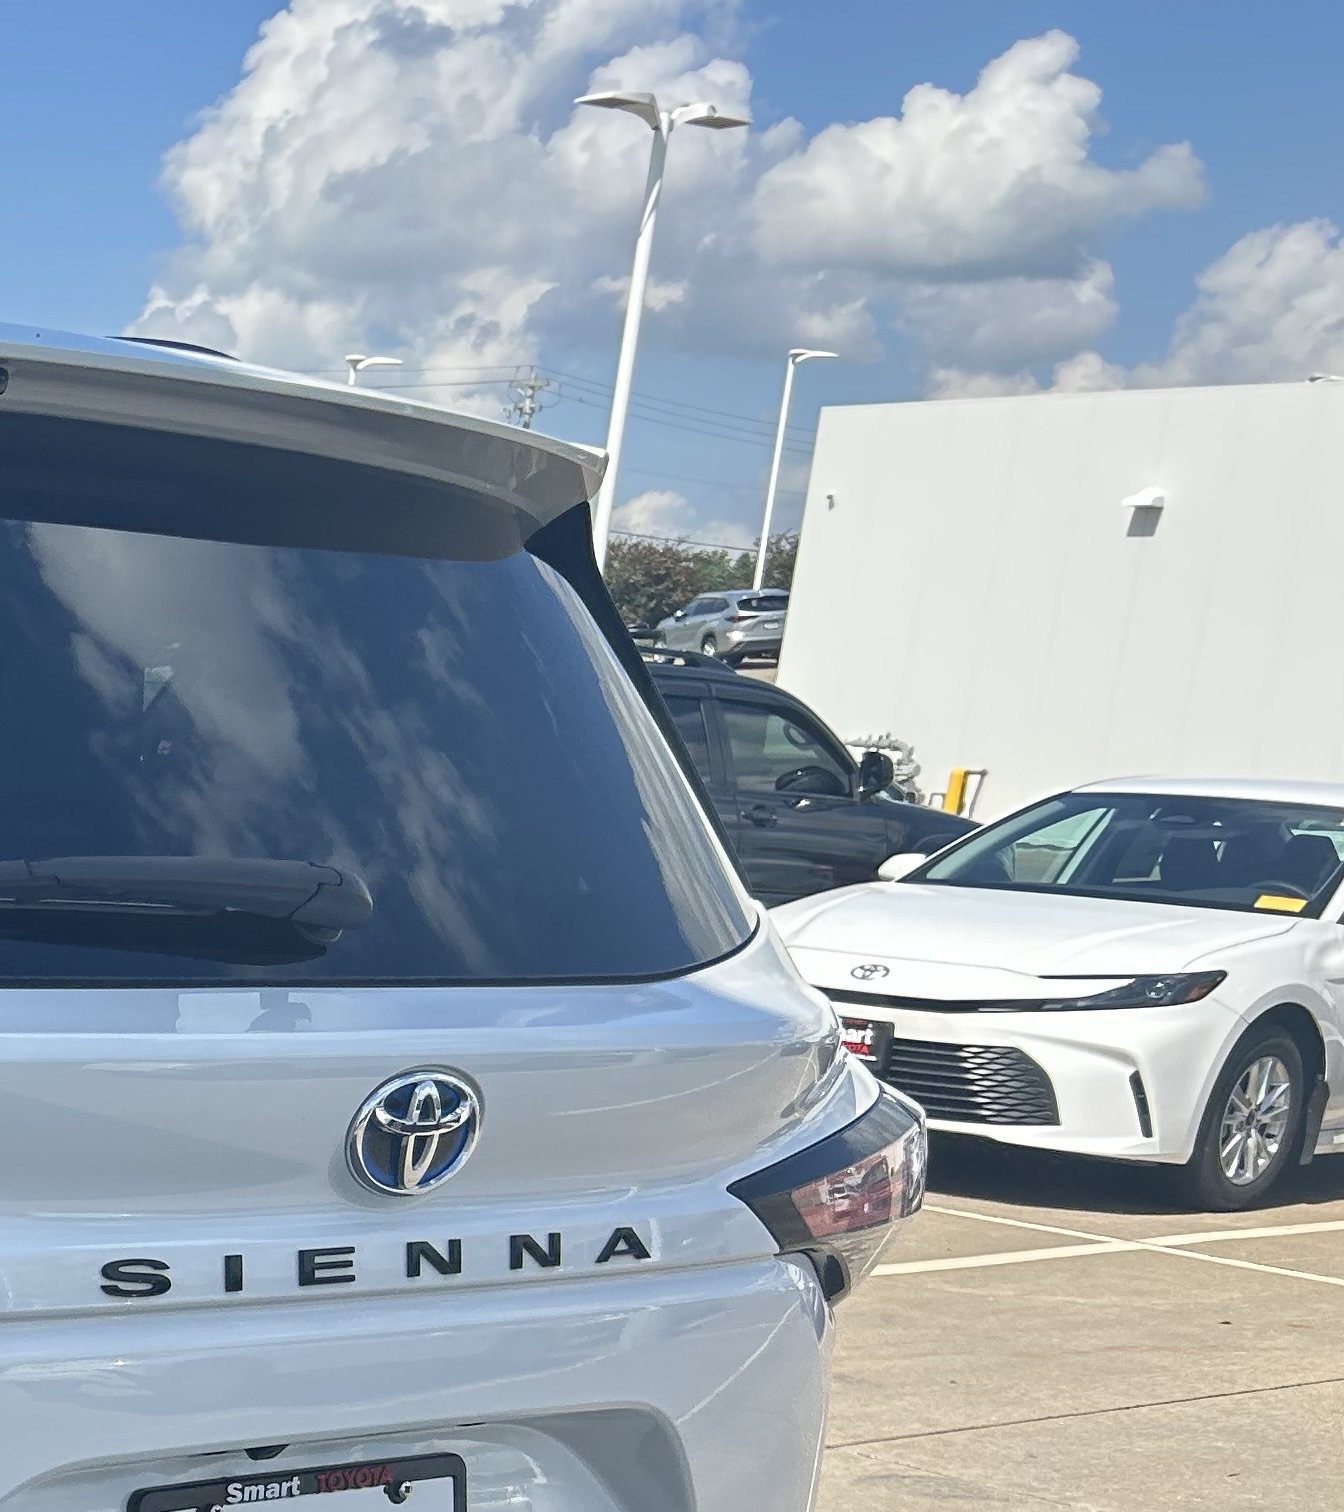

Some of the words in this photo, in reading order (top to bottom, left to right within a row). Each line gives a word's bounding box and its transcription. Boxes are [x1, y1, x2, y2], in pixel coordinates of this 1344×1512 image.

[99, 1226, 652, 1298] SIENNA
[226, 1475, 301, 1505] Smart
[316, 1464, 392, 1493] TOYOTA
